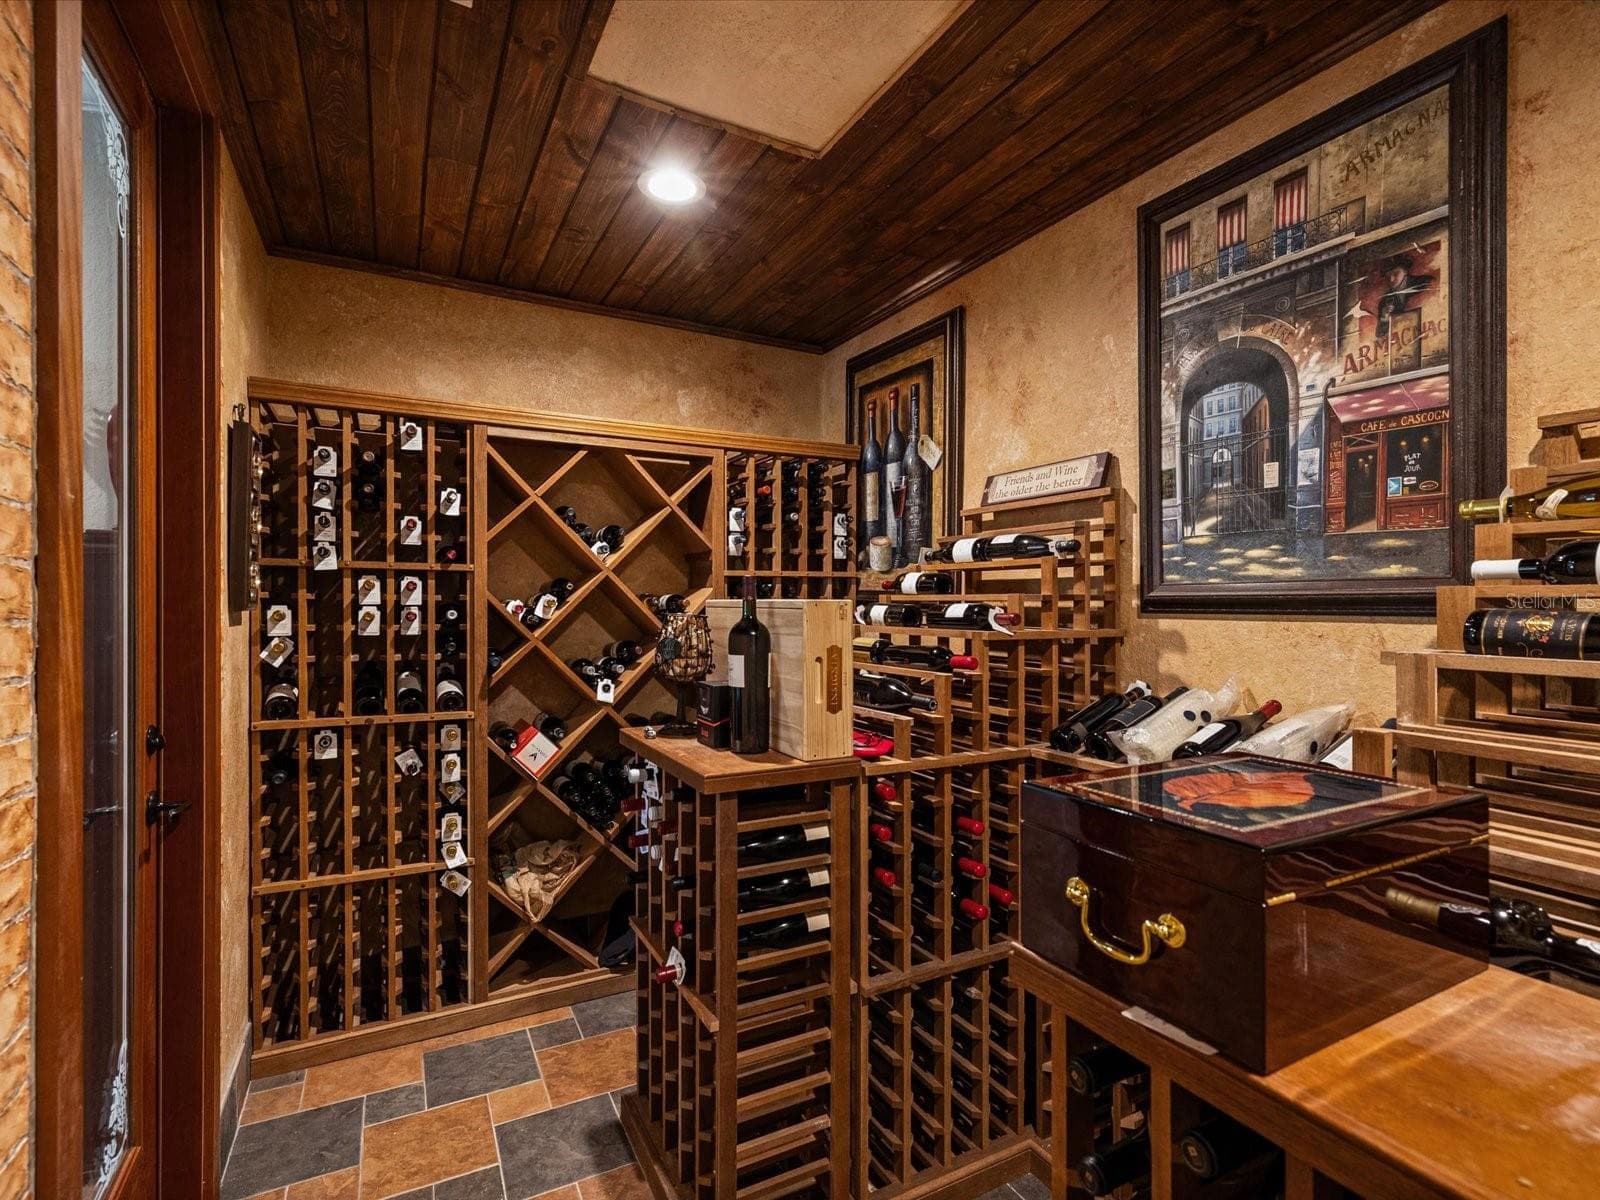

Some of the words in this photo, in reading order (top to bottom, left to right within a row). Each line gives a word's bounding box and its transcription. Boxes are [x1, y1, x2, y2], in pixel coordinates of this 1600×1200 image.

[1004, 472, 1034, 487] Friends
[1036, 467, 1052, 480] and
[1055, 464, 1079, 476] Wine
[995, 489, 1008, 499] the
[1010, 485, 1033, 496] older
[1035, 481, 1049, 492] the
[1053, 477, 1083, 489] better
